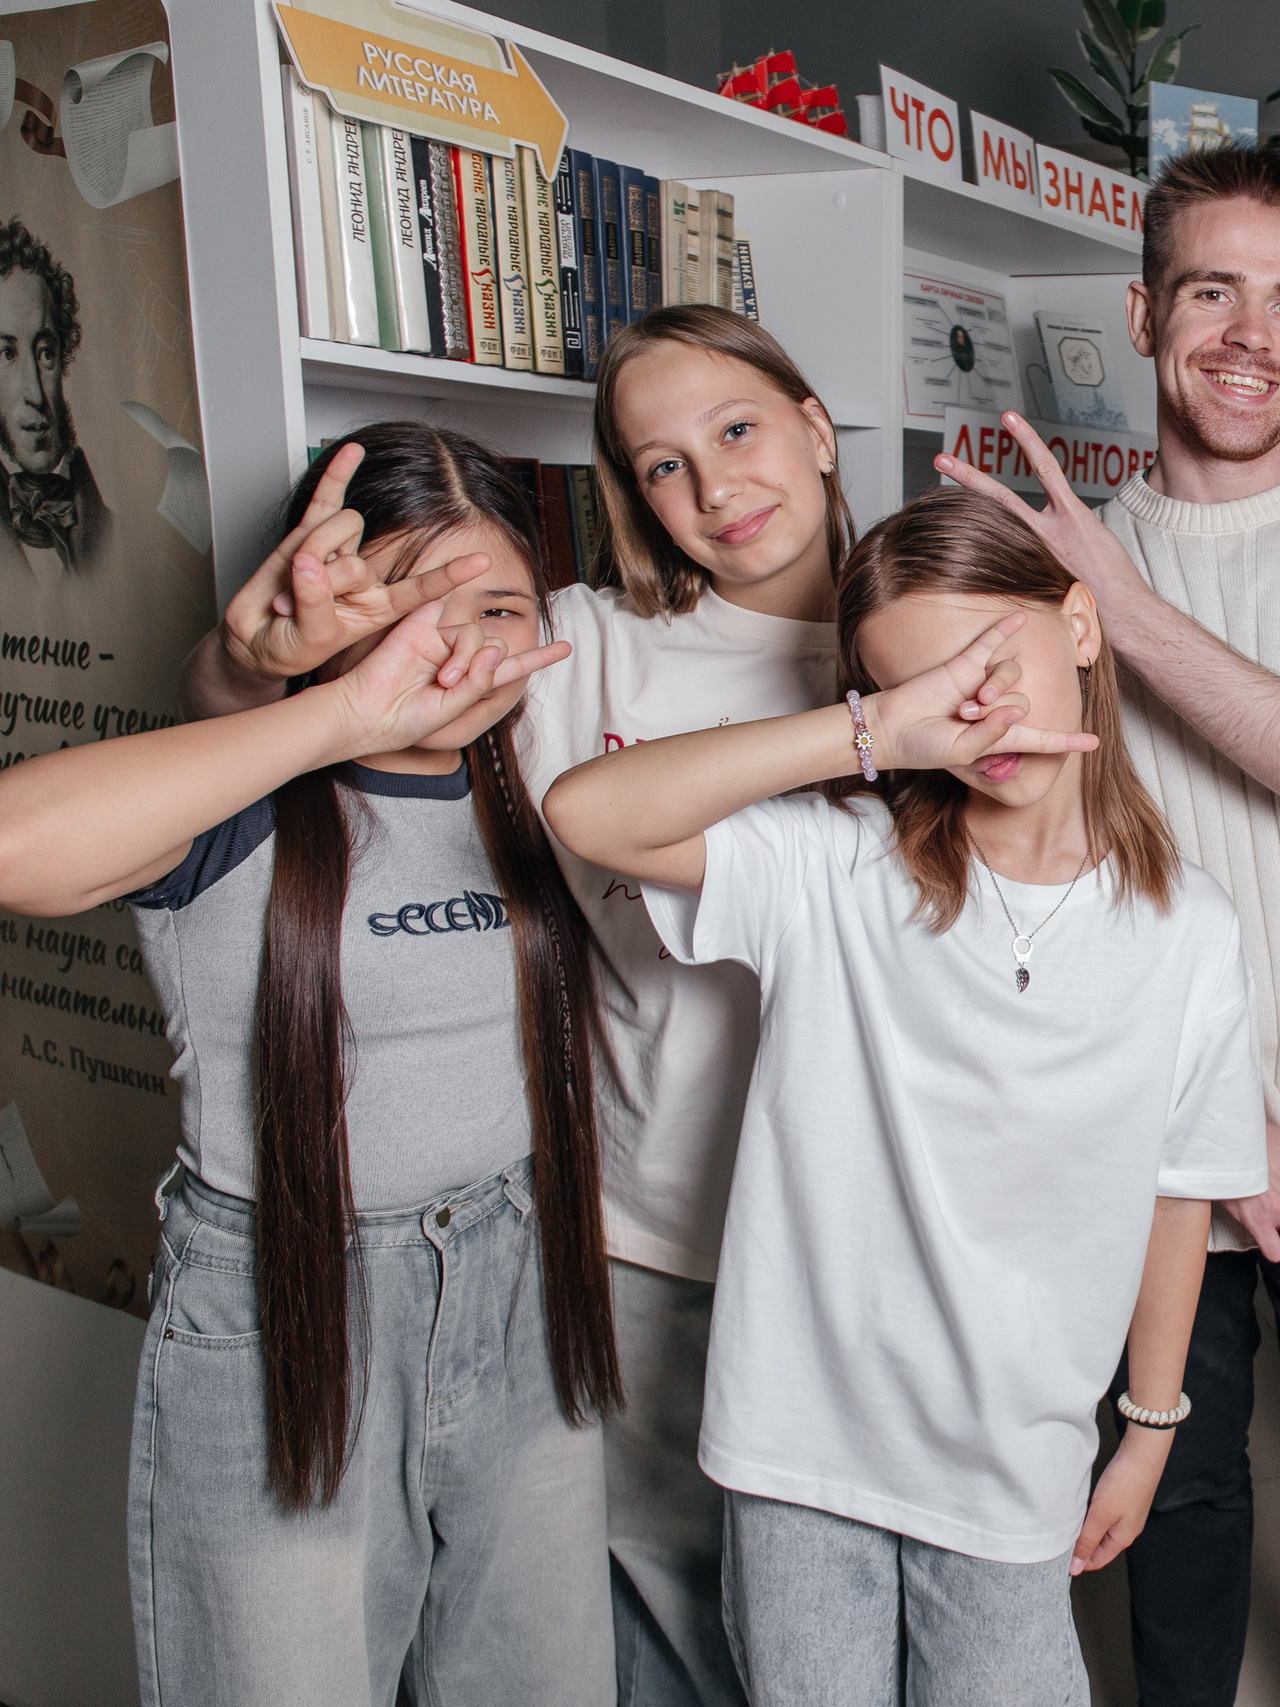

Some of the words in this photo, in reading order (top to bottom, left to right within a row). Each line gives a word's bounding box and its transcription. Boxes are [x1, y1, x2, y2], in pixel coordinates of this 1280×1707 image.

[362, 41, 478, 95] РУССКАЯ
[358, 66, 501, 125] ЛИТЕРАТУРА
[303, 108, 312, 146] АКСАКОВ
[890, 86, 954, 162] ЧТО
[983, 130, 1035, 195] МЫ
[350, 181, 365, 243] ЛЕОНИД
[398, 188, 414, 249] ЛЕОНИД
[423, 228, 437, 270] Леонид
[739, 245, 754, 289] БУНИН
[2, 632, 90, 670] тение
[0, 691, 84, 736] учшее
[26, 923, 106, 973] наука
[21, 1033, 65, 1067] А.С.
[69, 1045, 168, 1096] Пушкин
